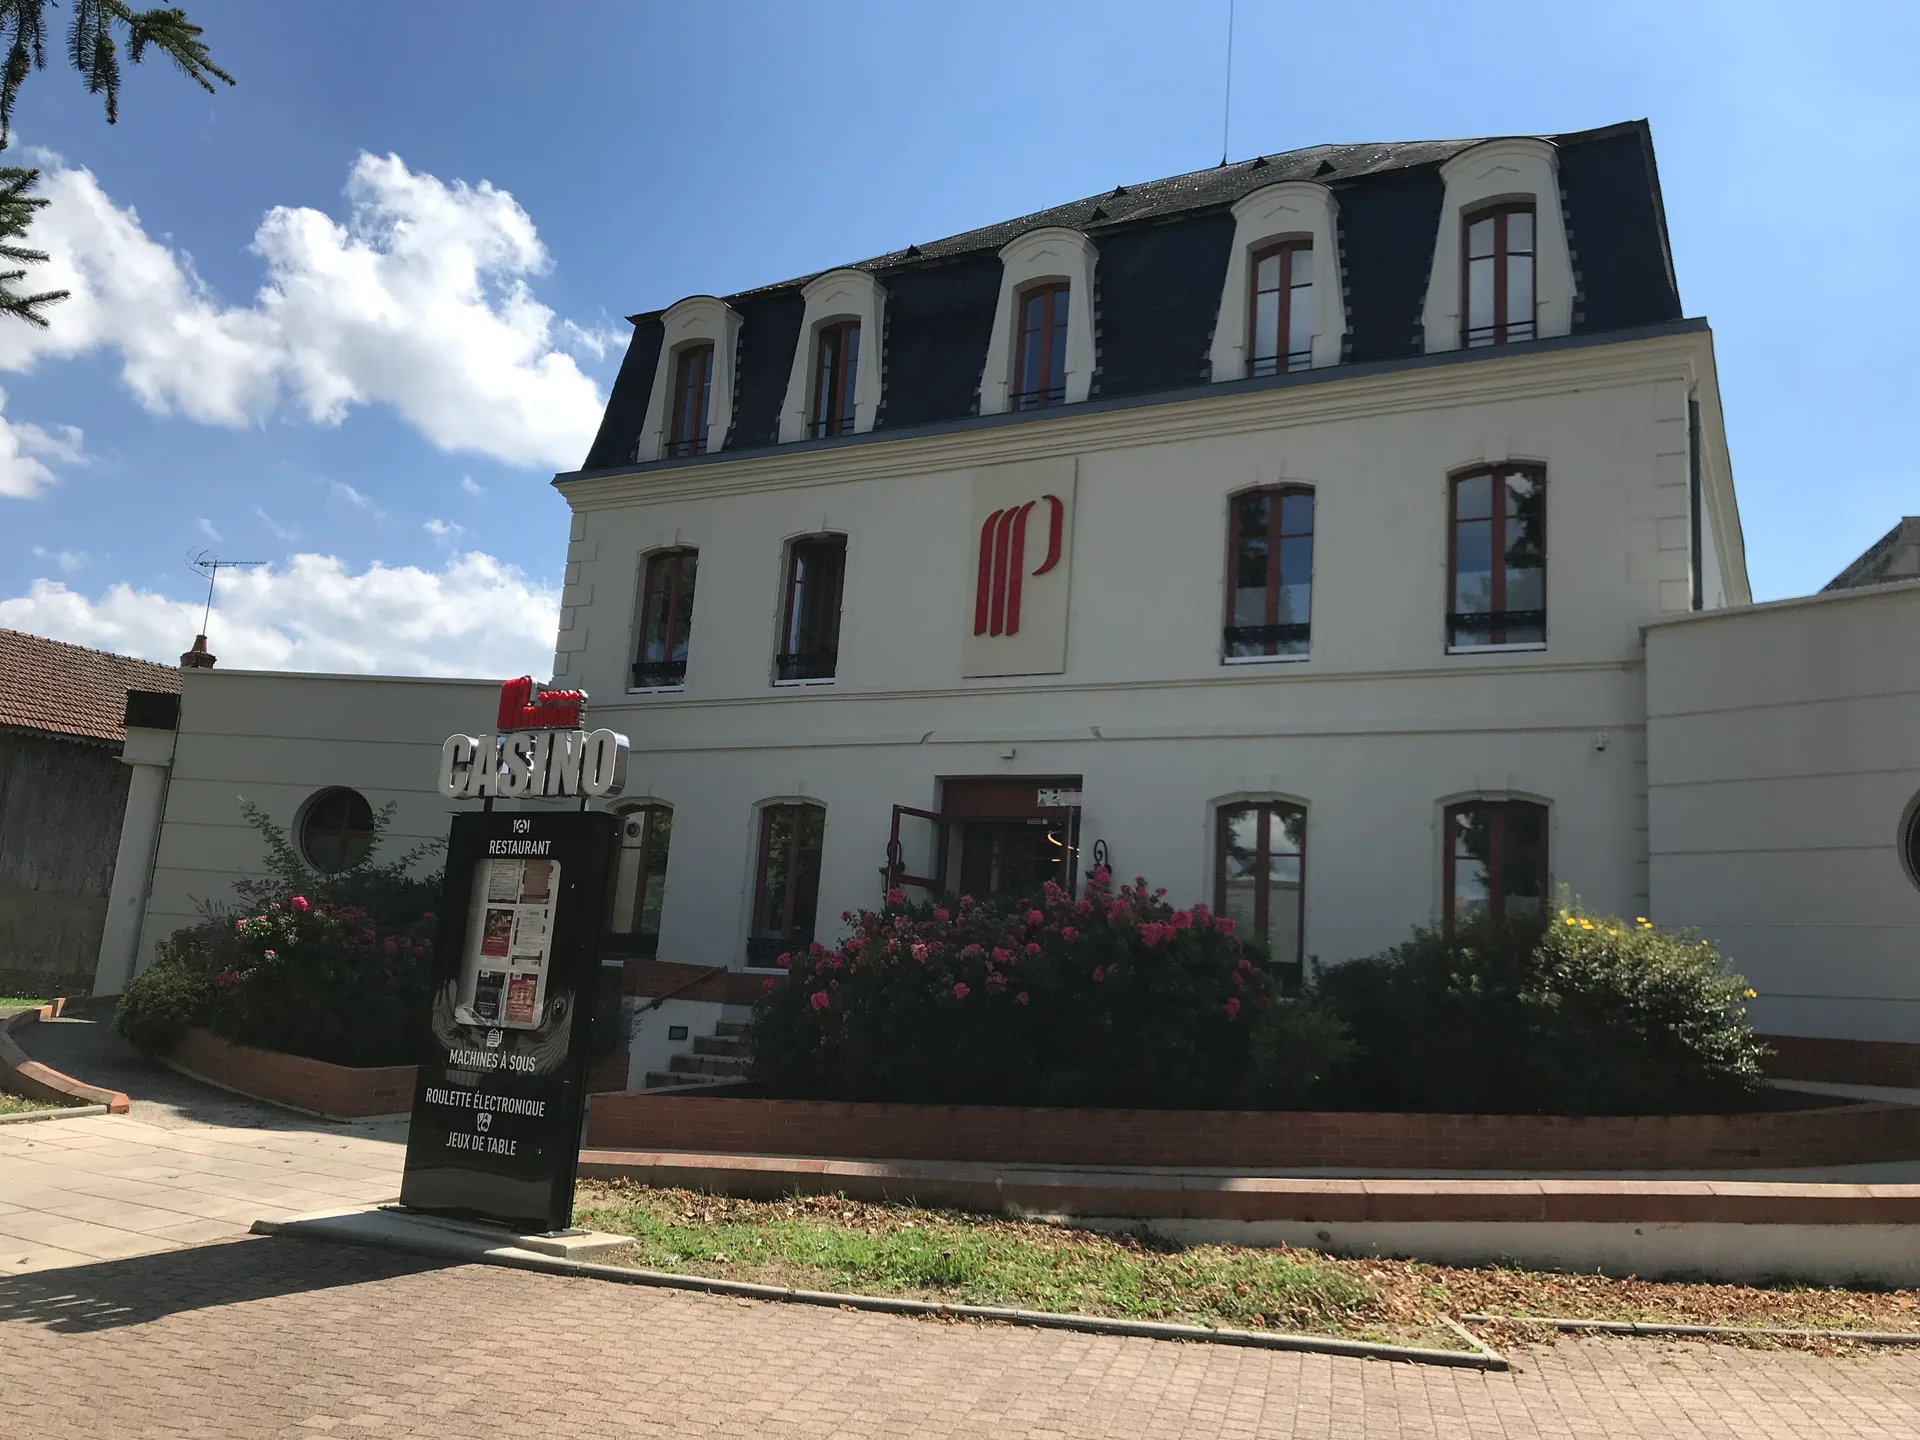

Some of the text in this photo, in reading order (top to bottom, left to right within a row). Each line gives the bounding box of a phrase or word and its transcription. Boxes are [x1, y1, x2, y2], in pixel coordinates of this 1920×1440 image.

[437, 728, 630, 799] CASINO
[488, 840, 552, 855] RESTAURANT
[449, 1048, 536, 1072] MACHINES À SOUS
[425, 1087, 546, 1117] ROULETTE ÉLECTRONIQUE
[445, 1131, 517, 1156] JEUX DE TABLE
